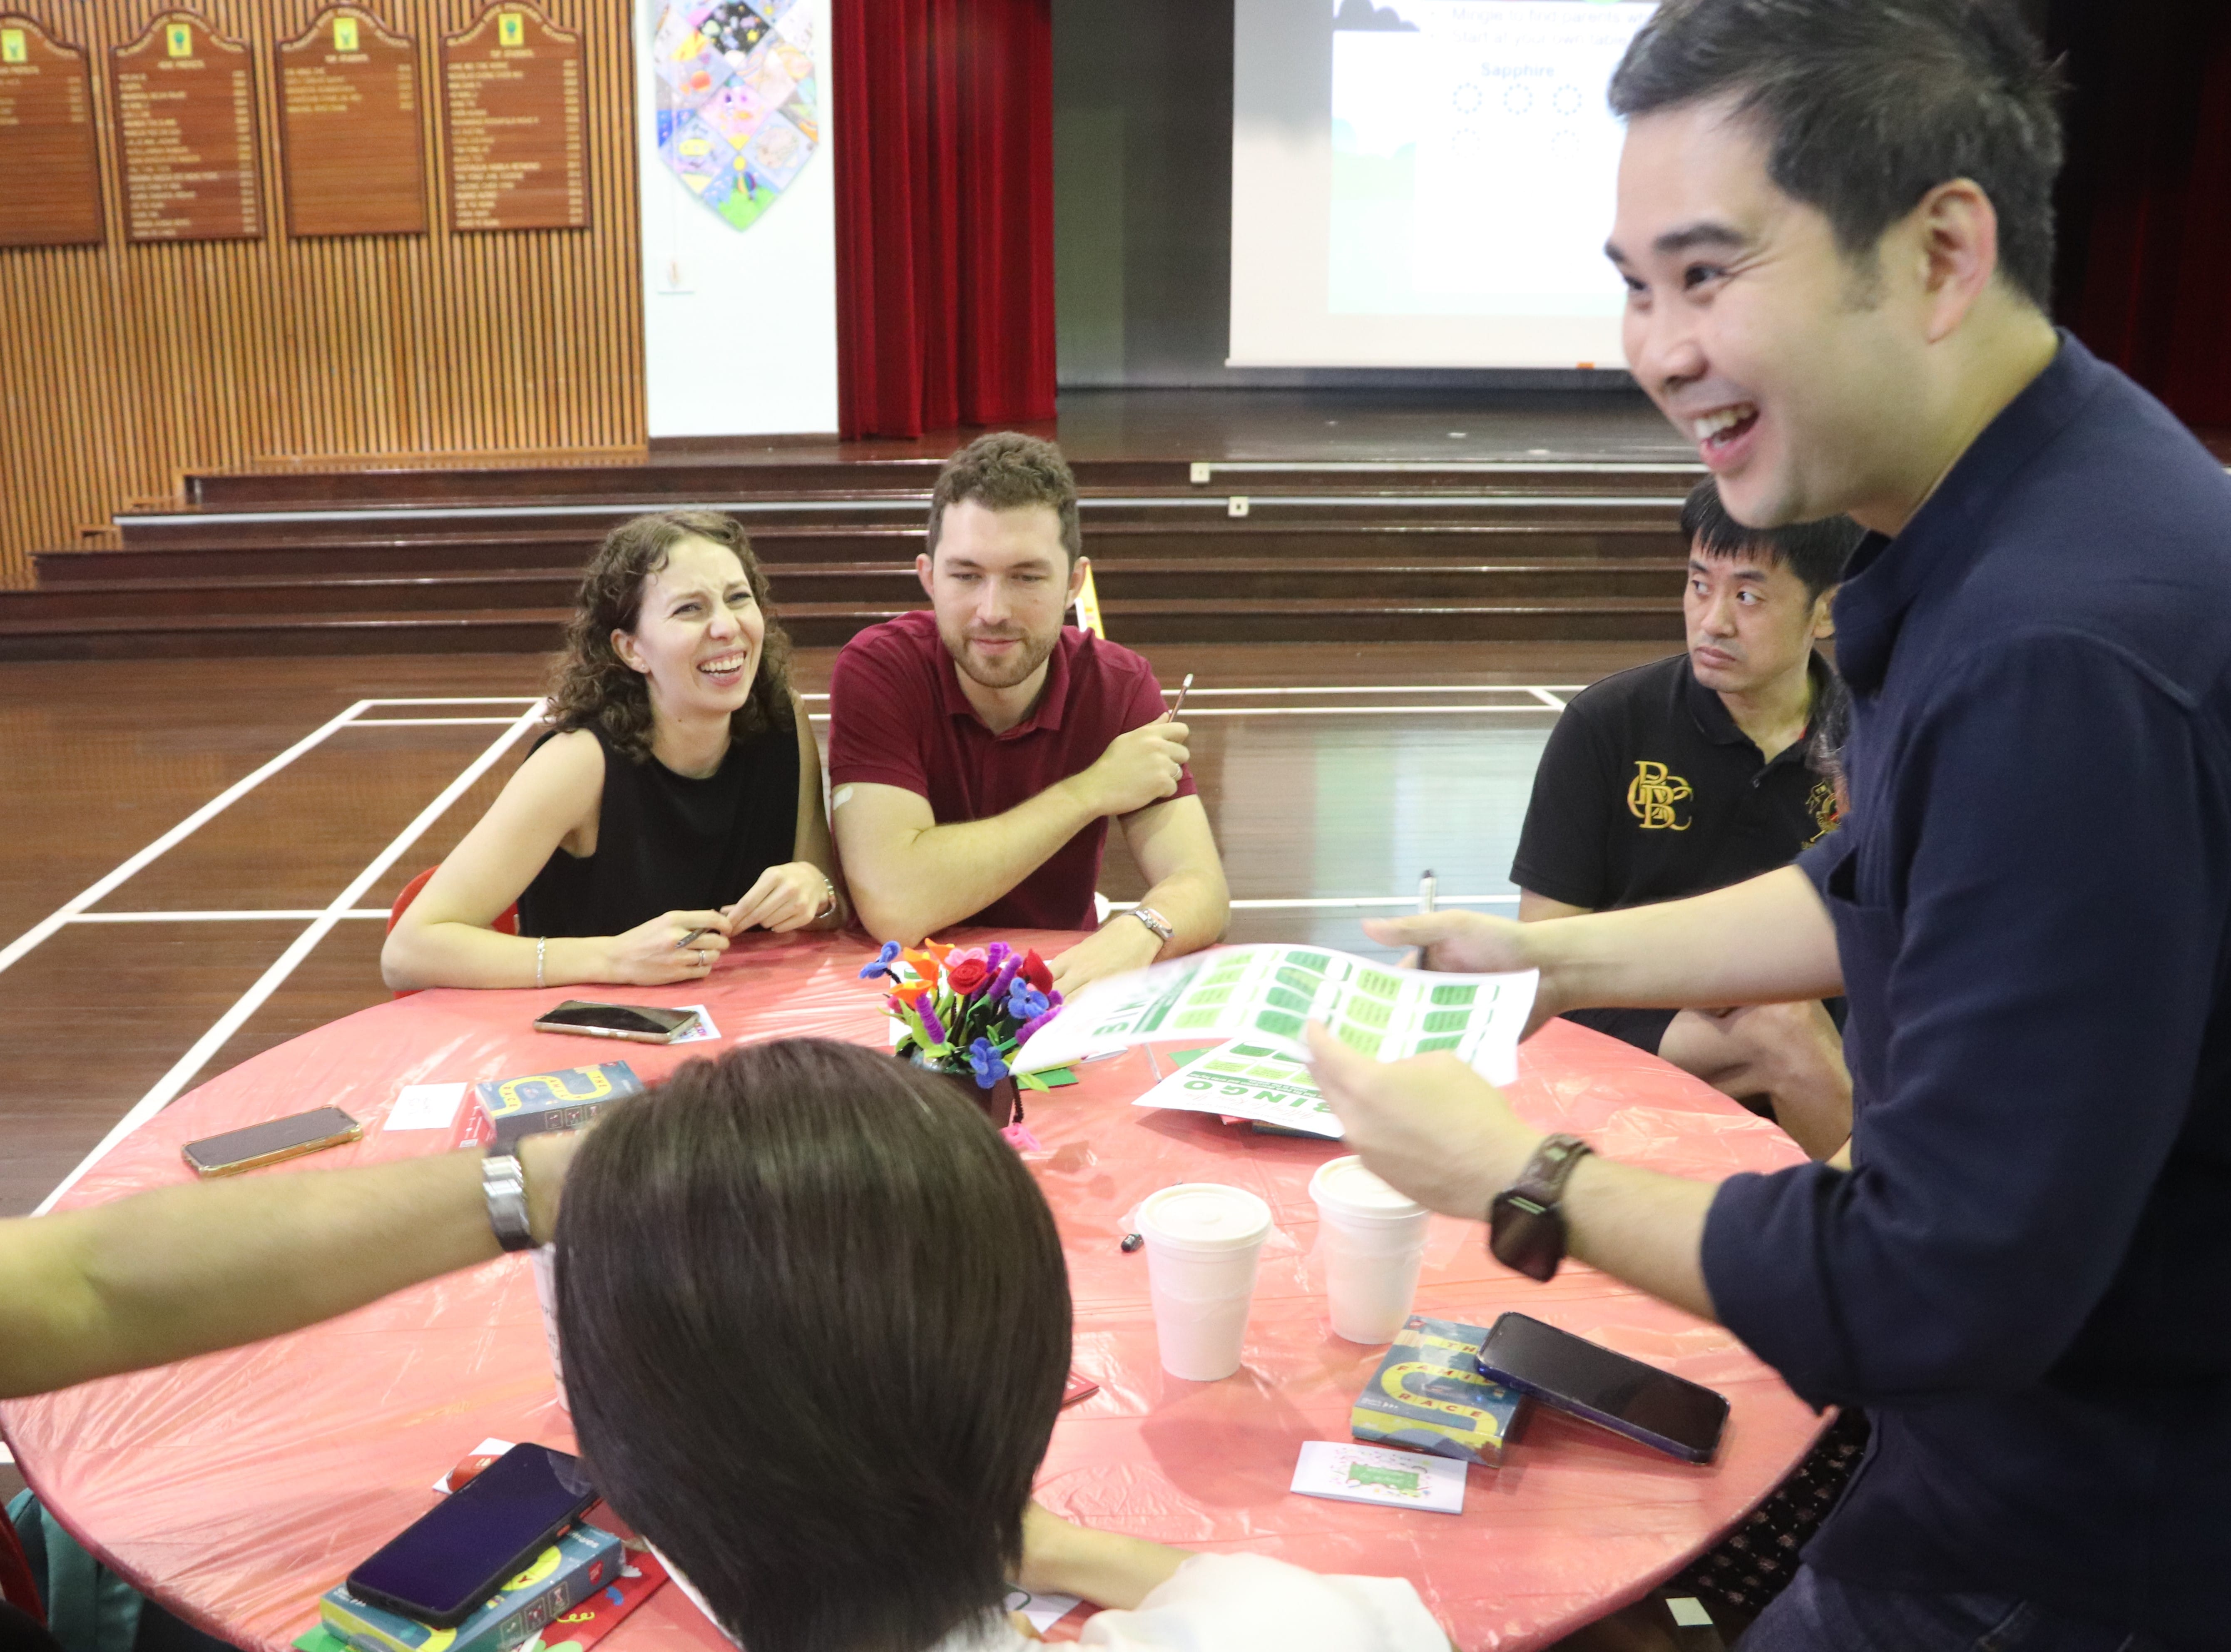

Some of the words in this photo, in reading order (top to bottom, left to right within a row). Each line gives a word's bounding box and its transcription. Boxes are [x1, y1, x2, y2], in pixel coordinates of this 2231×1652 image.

[1452, 7, 1503, 25] Mingle
[1510, 10, 1523, 22] to
[1529, 8, 1557, 22] find
[1562, 10, 1620, 25] parents
[1453, 29, 1488, 43] Start
[1494, 31, 1507, 43] at
[1515, 34, 1546, 46] your
[1553, 35, 1584, 44] own
[1481, 62, 1555, 80] Sapphire
[503, 1086, 518, 1107] RACE
[1183, 1080, 1335, 1114] BINGO
[1447, 1341, 1477, 1353] TH
[1398, 1393, 1482, 1417] RACE
